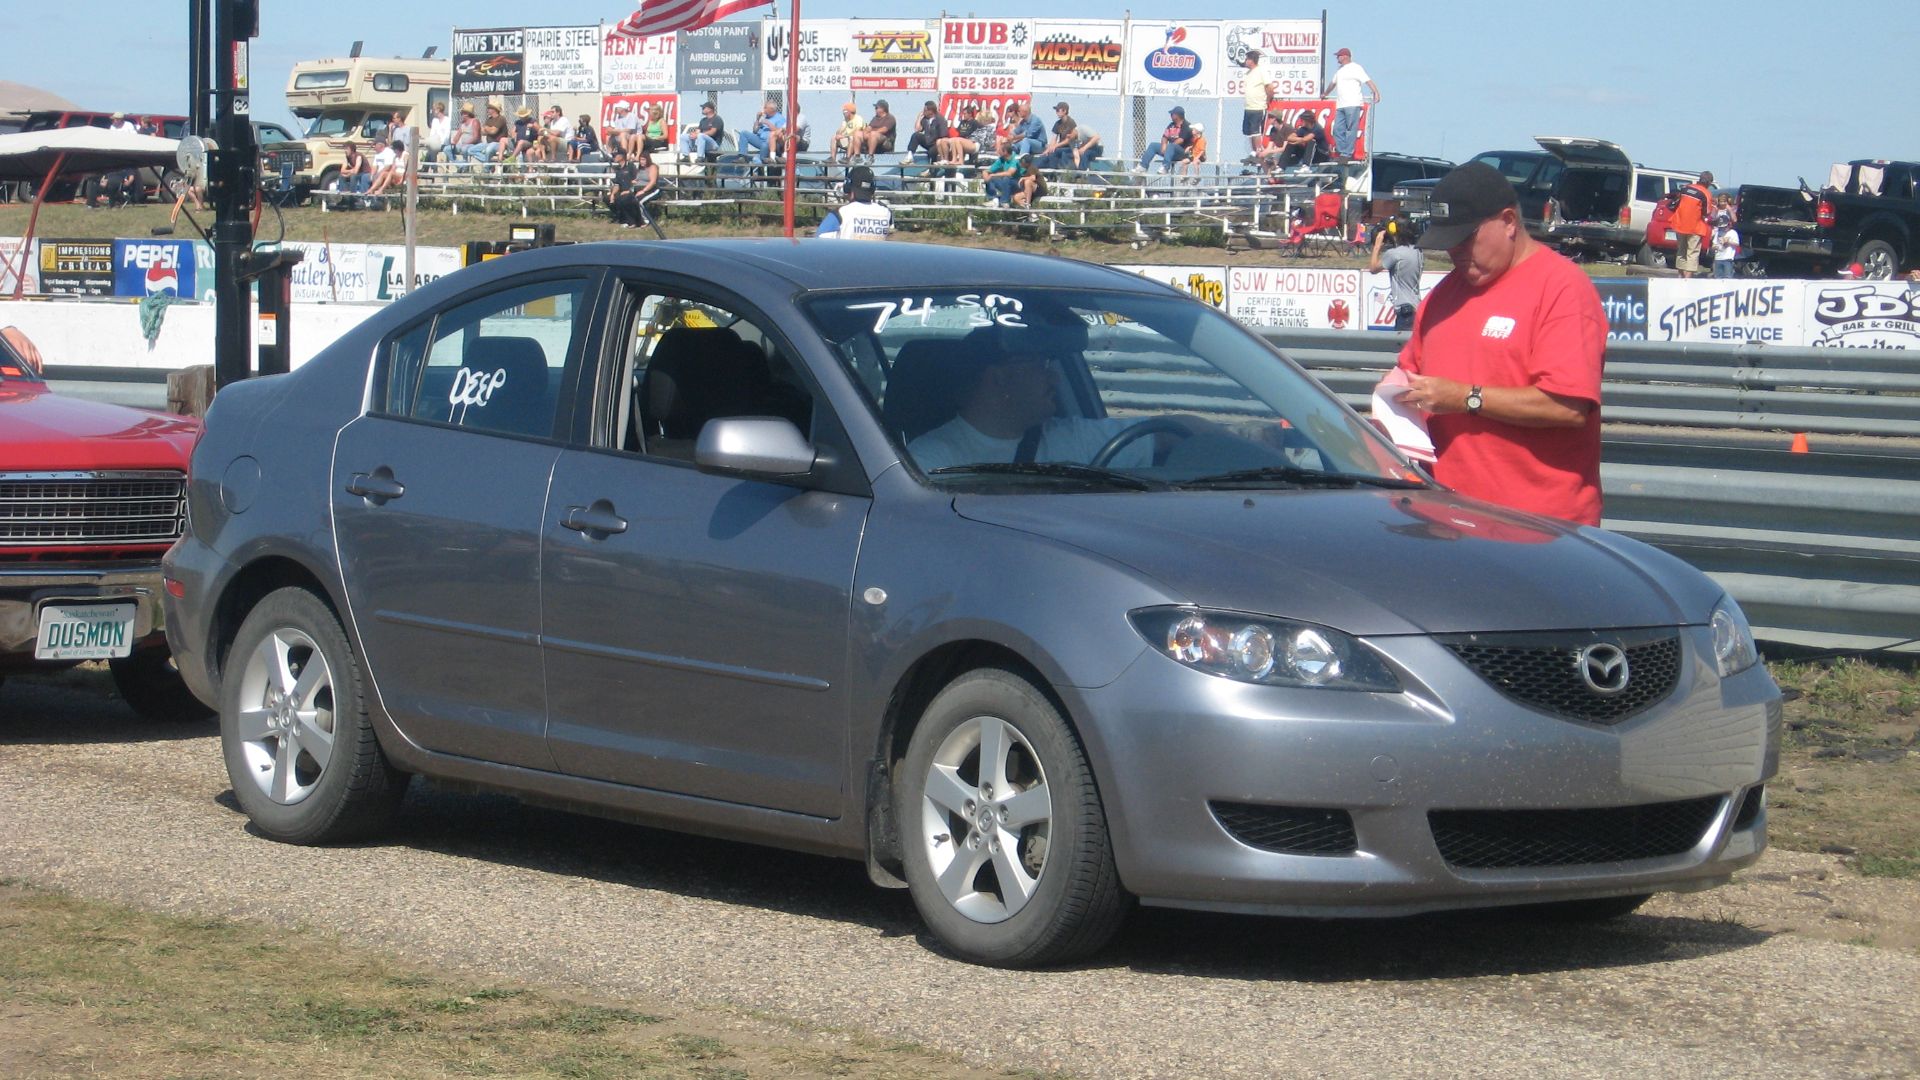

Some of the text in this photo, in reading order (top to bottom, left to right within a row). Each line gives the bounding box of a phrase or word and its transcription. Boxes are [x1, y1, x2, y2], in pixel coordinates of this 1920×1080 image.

[526, 29, 598, 48] PRAIRIE STEEL
[723, 26, 750, 37] PAINT
[944, 22, 1008, 45] HUB
[604, 36, 676, 56] RENT-IT
[713, 40, 721, 50] &
[855, 30, 935, 62] LAZER
[1261, 32, 1320, 50] EXTREME
[540, 49, 581, 61] PRODUCTS
[690, 53, 747, 62] AIRBRUSHING
[1033, 43, 1120, 62] MOPAC
[1032, 62, 1117, 71] PERFORMANCE
[1152, 52, 1195, 69] Custom
[952, 76, 1015, 90] 652-3822
[853, 217, 888, 227] NITRO
[853, 226, 889, 235] IMAGE
[58, 246, 111, 255] IMPRESSIONS
[124, 245, 180, 269] PEPSI
[290, 261, 326, 286] utler
[1189, 273, 1225, 306] Tire
[1233, 272, 1357, 294] SJW HOLDINGS
[295, 288, 335, 300] INSURANC
[1247, 297, 1281, 306] CERTIFIED
[846, 297, 936, 334] 74
[1237, 307, 1306, 317] FIRE RESCUE
[1660, 285, 1785, 341] STREETWISE
[1269, 317, 1309, 328] TRAINING
[1842, 320, 1917, 332] BAR & GRILL
[1710, 326, 1783, 340] SERVICE
[449, 367, 507, 407] DEEP
[48, 621, 126, 648] DUSMON
